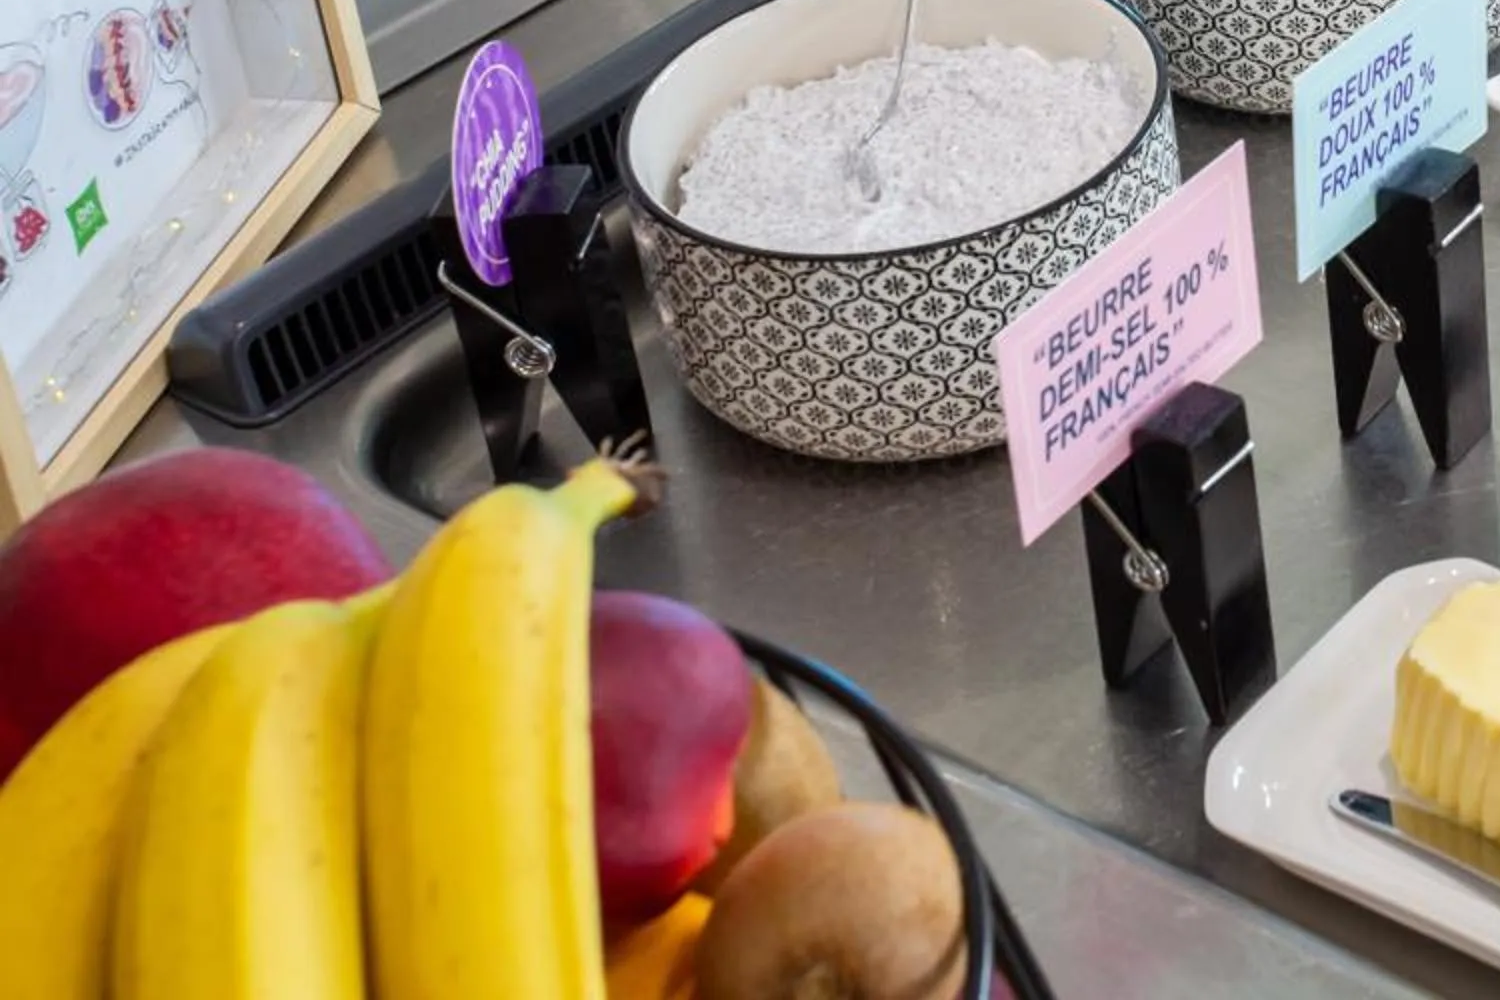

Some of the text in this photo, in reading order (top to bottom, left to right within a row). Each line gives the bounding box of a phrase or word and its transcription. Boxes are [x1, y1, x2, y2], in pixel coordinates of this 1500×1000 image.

[1319, 101, 1376, 169] DOUX
[1384, 72, 1414, 114] 100
[1418, 56, 1435, 88] %
[1039, 310, 1157, 425] DEMI-SEL
[1163, 263, 1201, 316] 100
[1207, 240, 1229, 282] %
